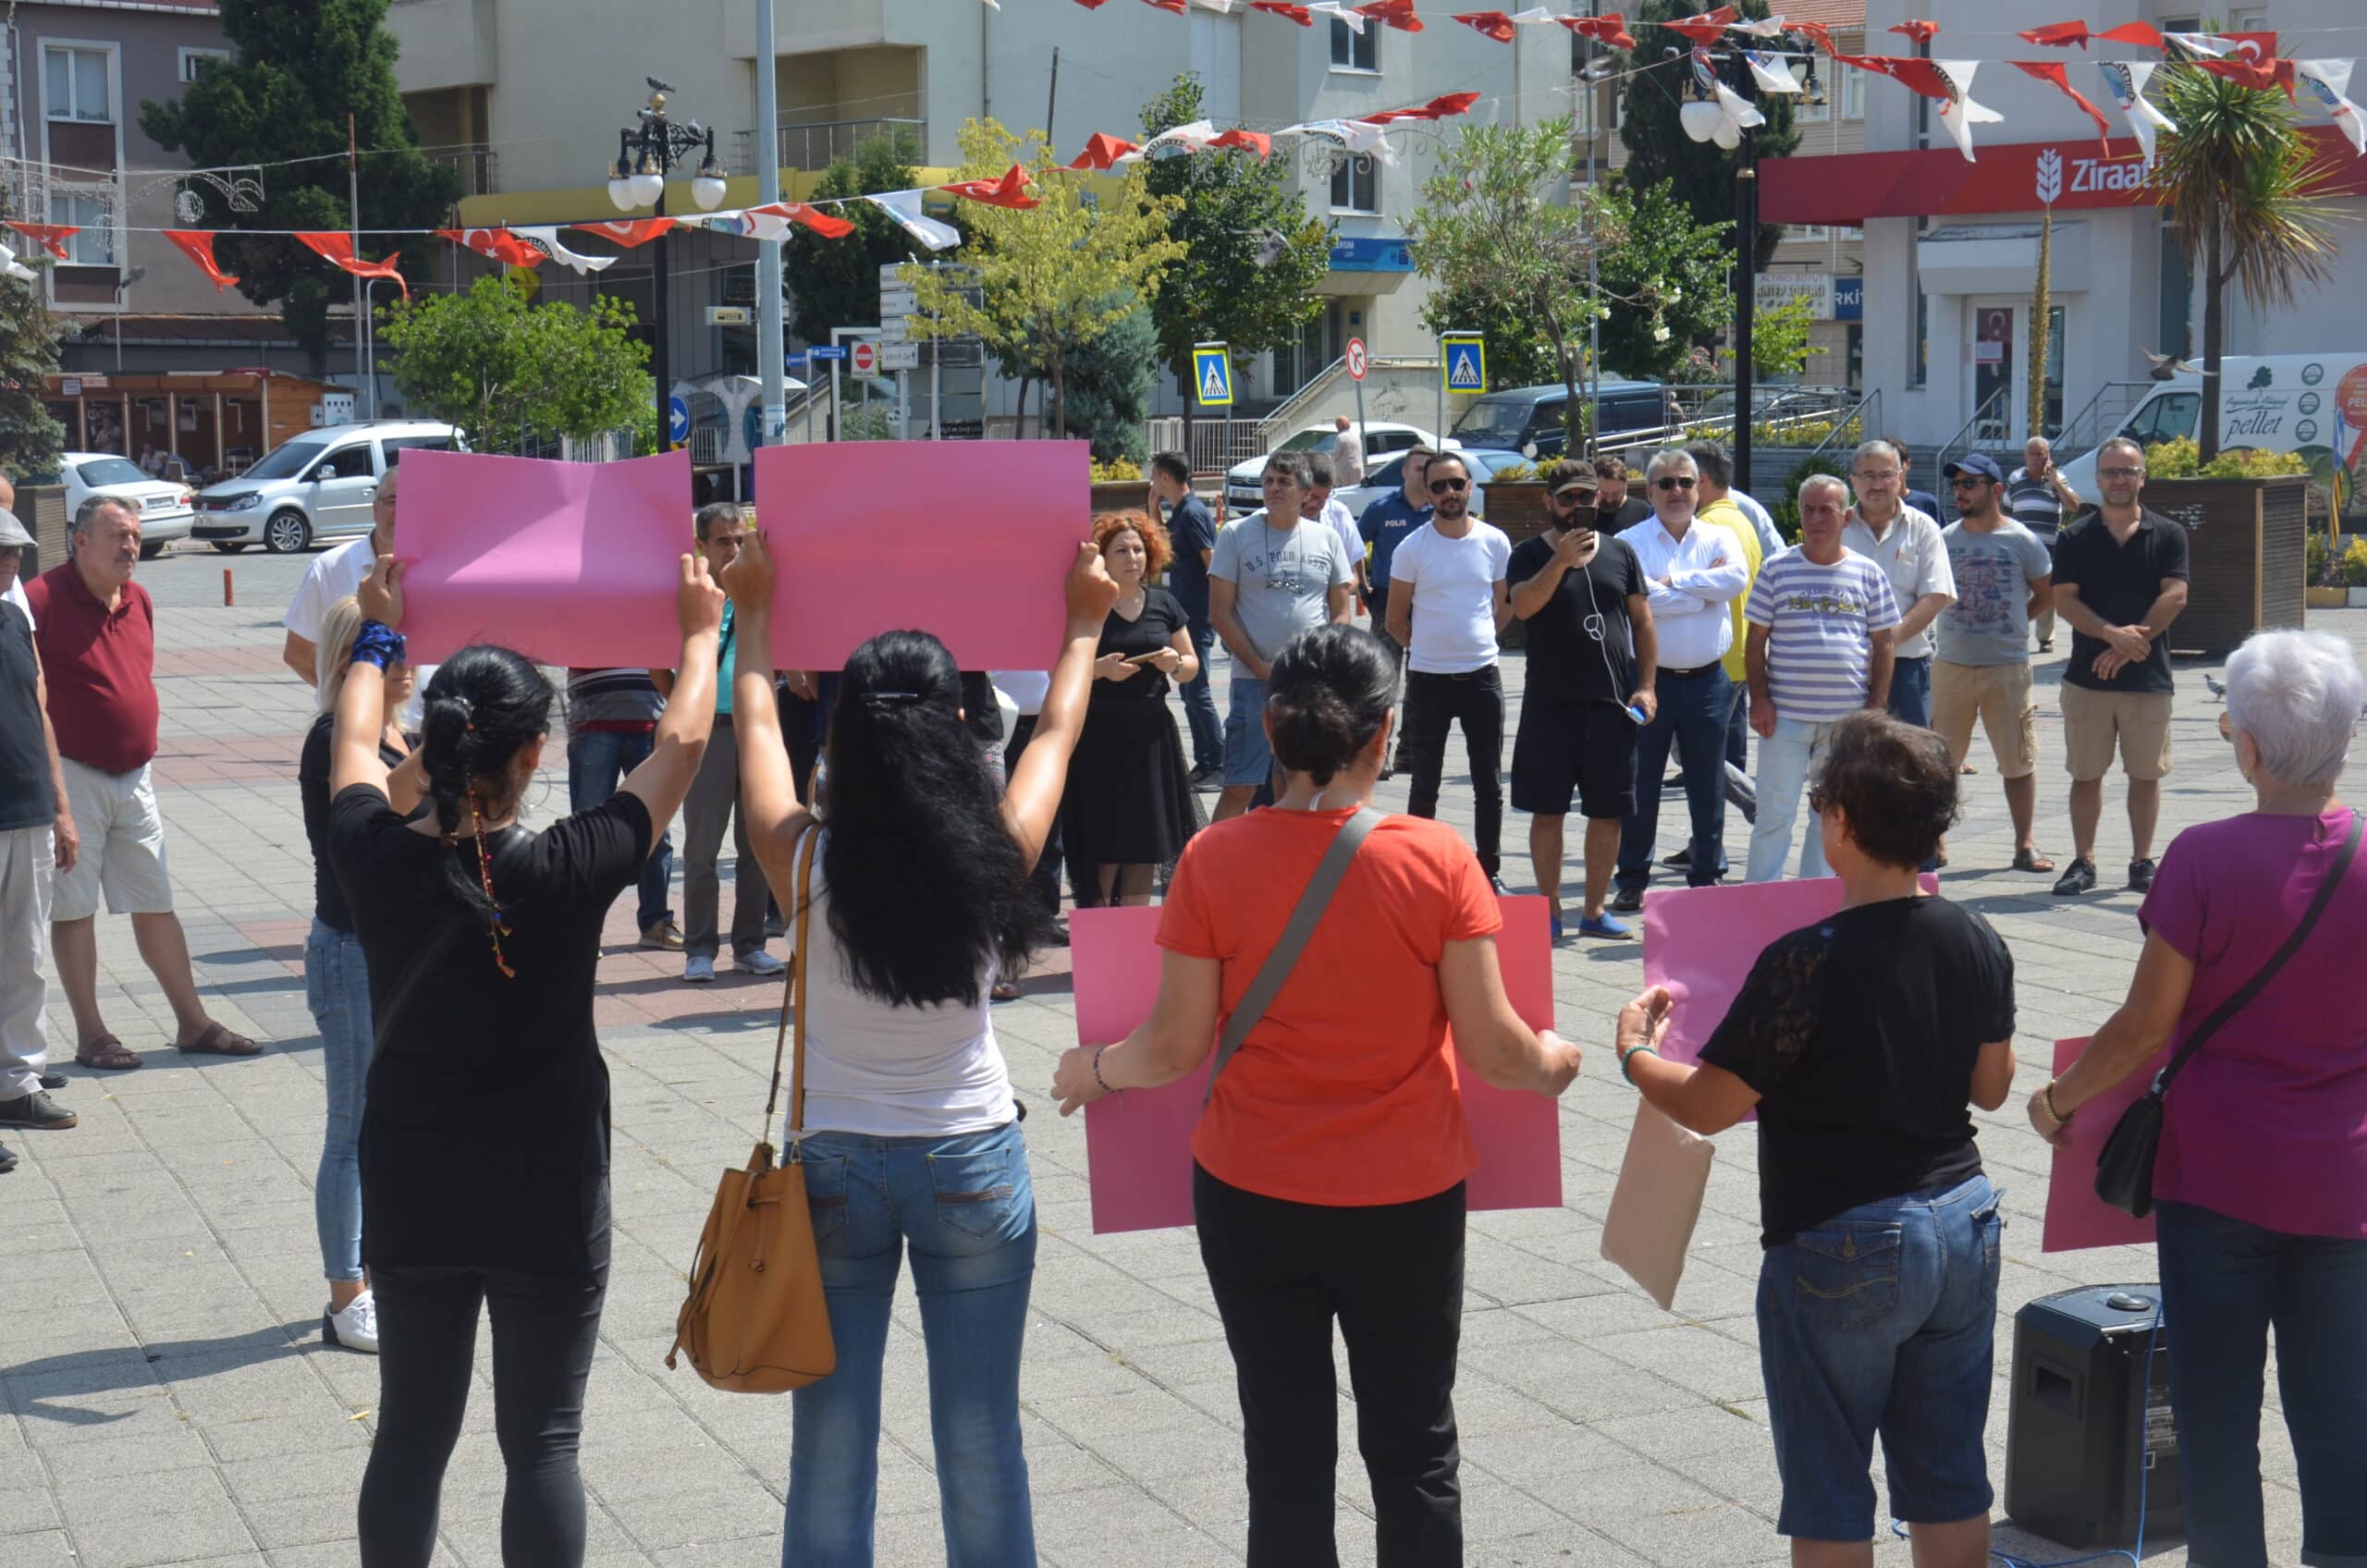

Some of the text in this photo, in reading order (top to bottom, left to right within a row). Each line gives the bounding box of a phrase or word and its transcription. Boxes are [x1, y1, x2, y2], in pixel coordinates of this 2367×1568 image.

[2070, 158, 2152, 192] Ziraat
[2225, 410, 2283, 444] pellet
[1269, 550, 1295, 563] POLO
